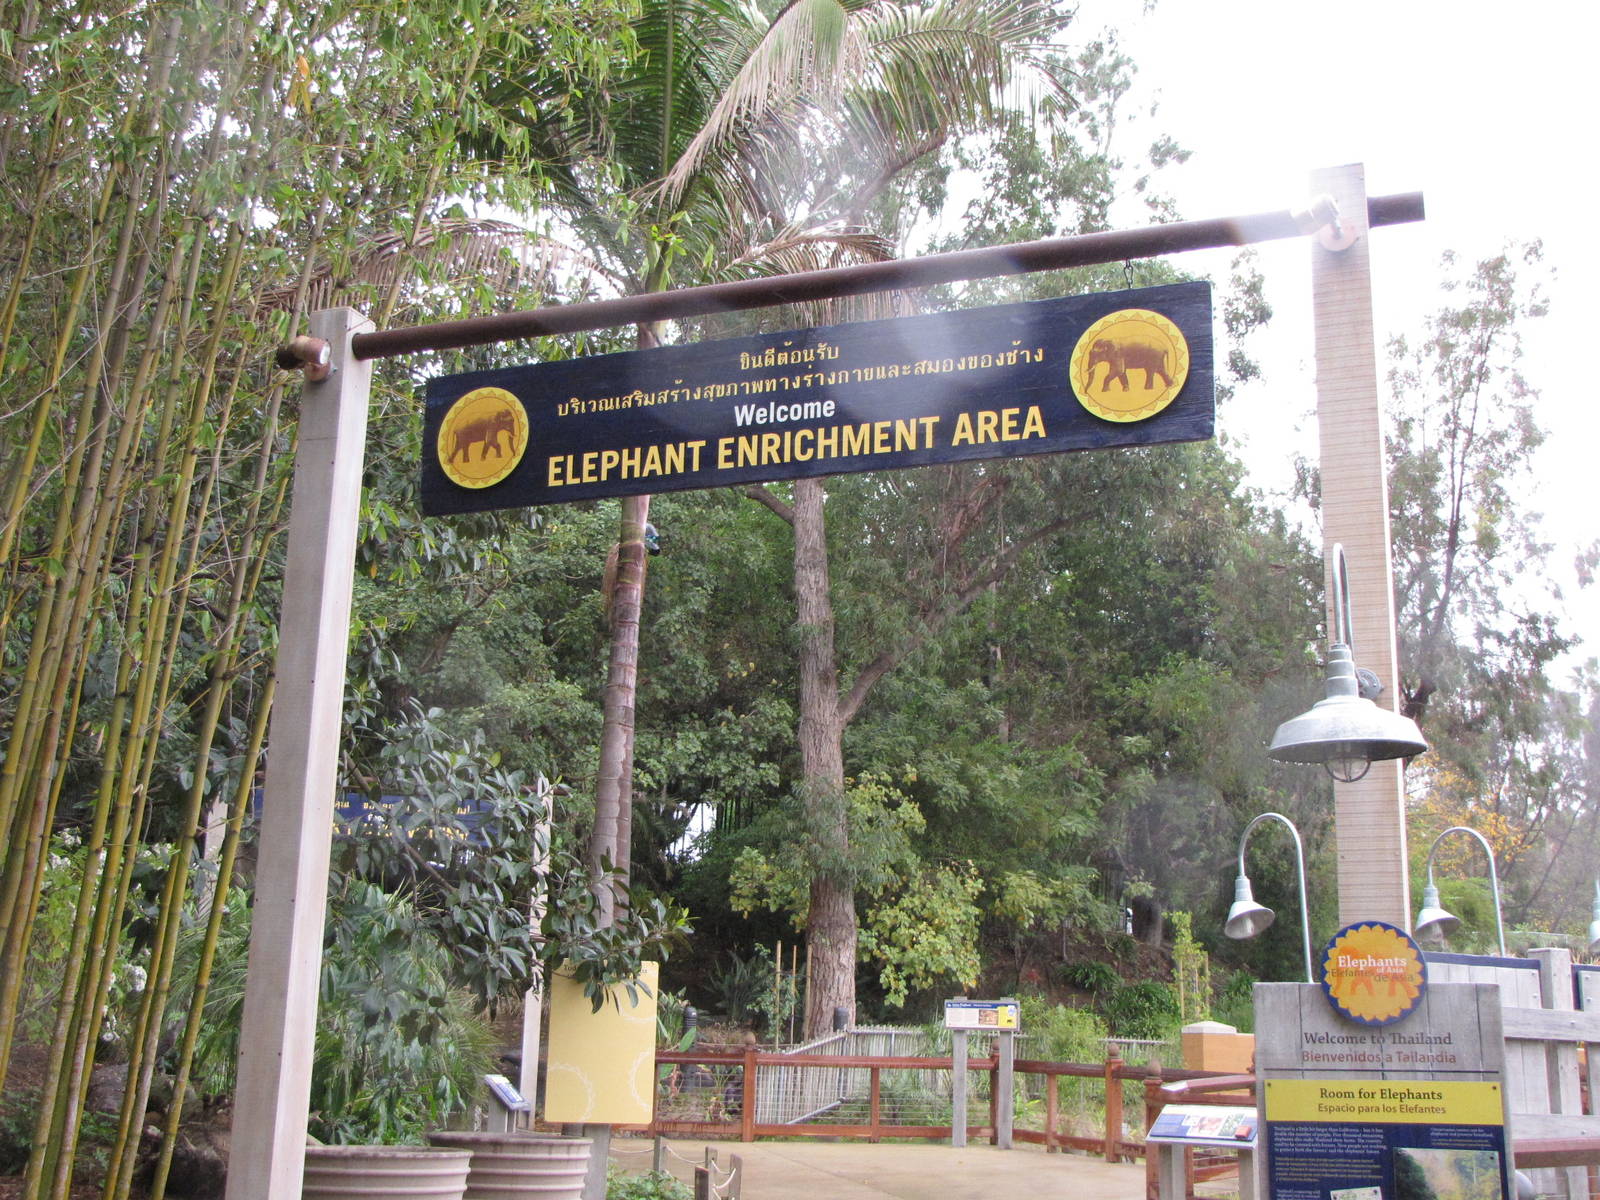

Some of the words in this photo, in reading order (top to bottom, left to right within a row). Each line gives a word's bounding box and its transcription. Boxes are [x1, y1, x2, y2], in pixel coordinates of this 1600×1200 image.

[734, 400, 836, 427] Welcome
[547, 440, 706, 487] ELEPHANT
[717, 416, 940, 470] ENRICHMENT
[952, 405, 1047, 447] AREA
[1337, 955, 1408, 970] Elephants
[1304, 1032, 1367, 1045] Welcome
[1371, 1034, 1386, 1045] to
[1390, 1032, 1453, 1045] Thailand
[1302, 1051, 1381, 1063] Bienvenidos
[1385, 1054, 1393, 1063] a
[1396, 1051, 1457, 1063] Tailandia
[1320, 1088, 1355, 1099] Room
[1358, 1088, 1377, 1099] for
[1380, 1088, 1443, 1102] Elephants
[1318, 1103, 1355, 1114] Espacio
[1358, 1105, 1380, 1114] para
[1382, 1104, 1398, 1113] los
[1400, 1104, 1447, 1114] Elefantes
